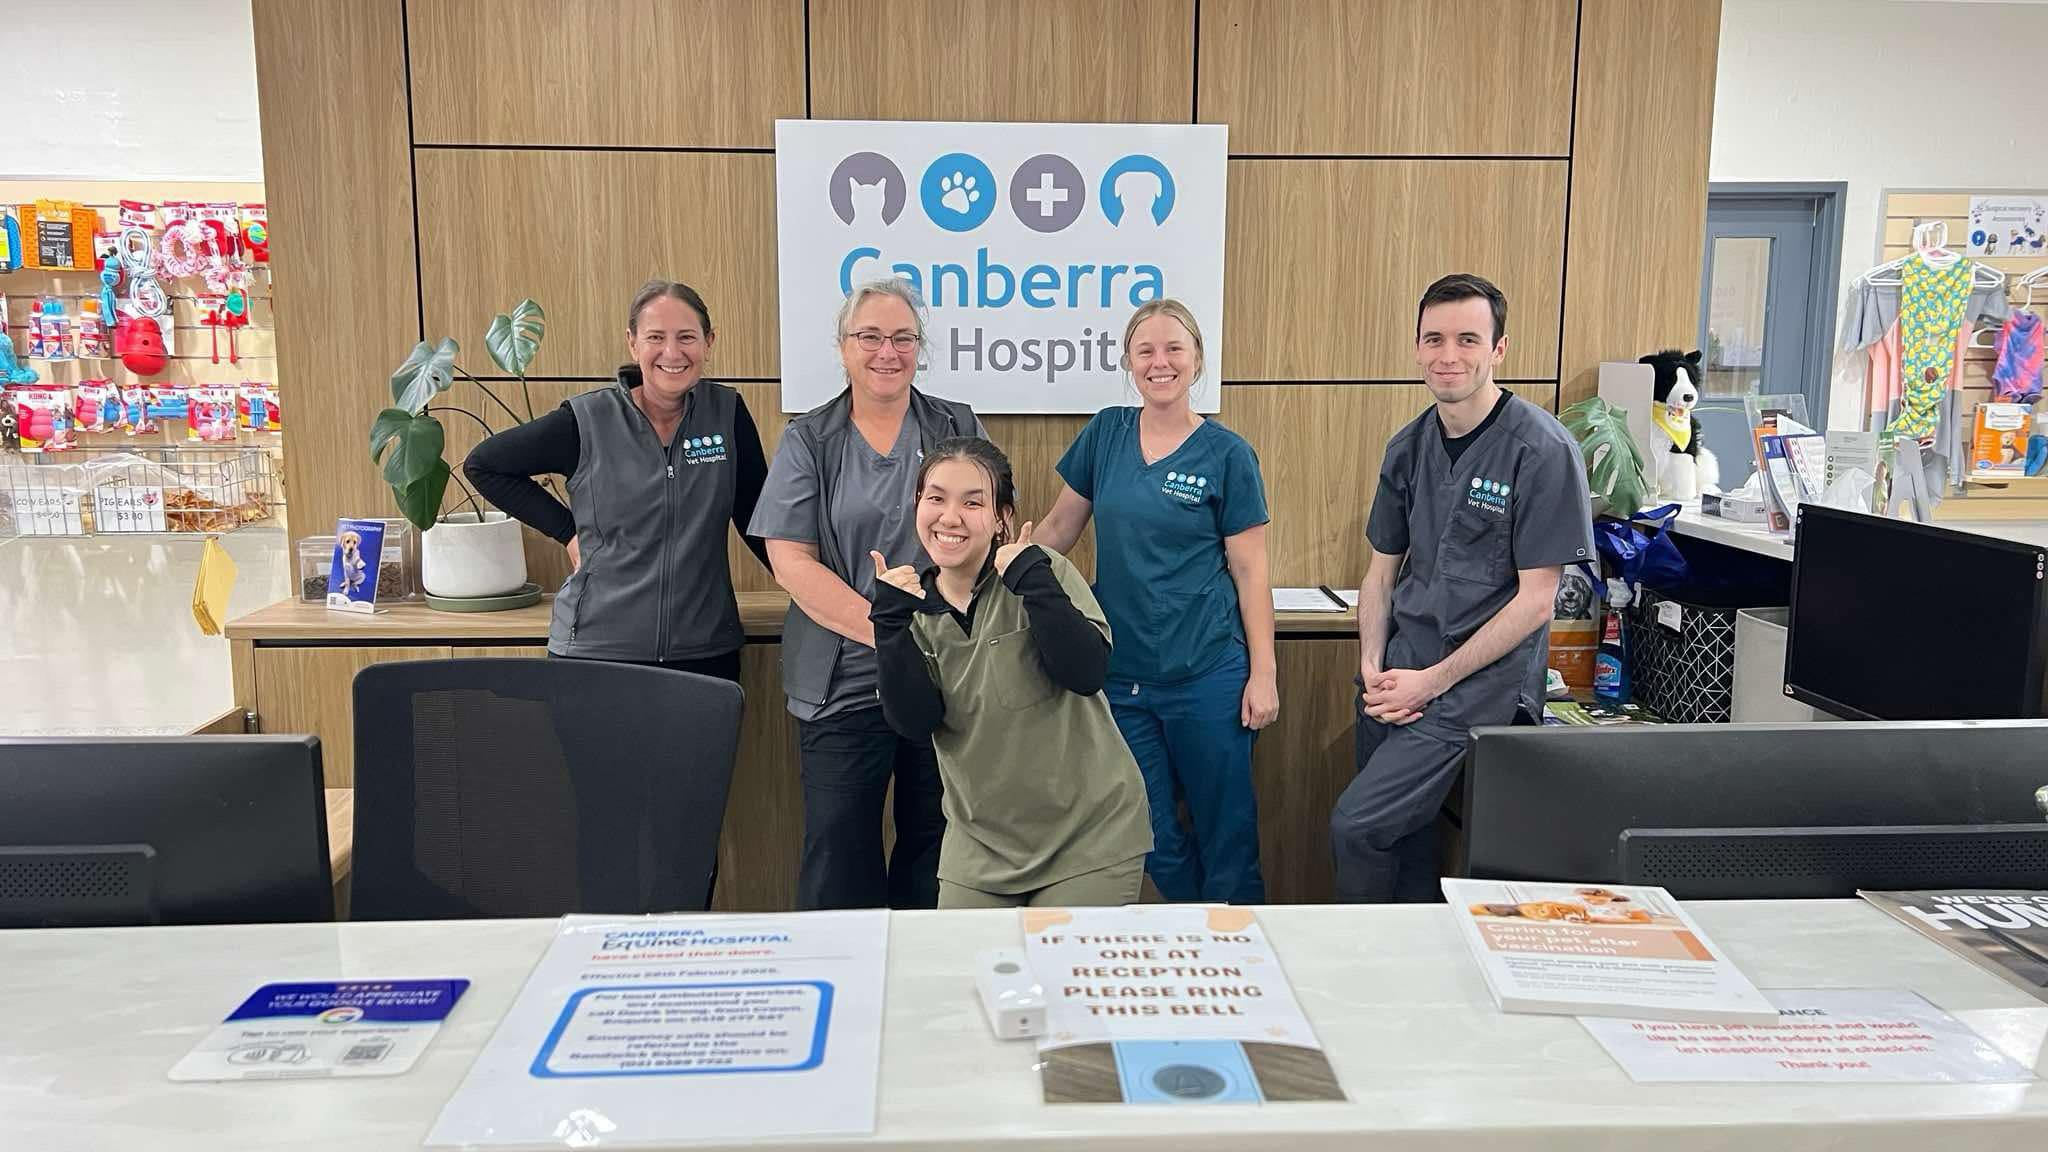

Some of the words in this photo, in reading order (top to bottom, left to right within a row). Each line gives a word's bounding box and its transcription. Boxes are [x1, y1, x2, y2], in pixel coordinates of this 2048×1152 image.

[840, 246, 1164, 308] Canberra
[950, 327, 1132, 383] Hospit
[685, 446, 725, 457] Canberra
[700, 454, 727, 463] Hospital
[1164, 480, 1203, 496] Canberra
[1173, 490, 1201, 503] Hospital
[1469, 488, 1506, 506] Canberra
[1467, 498, 1480, 508] Vet
[1481, 502, 1505, 515] Hospital
[1931, 895, 2031, 905] WE'RE
[604, 930, 705, 939] CANBERRA
[1487, 924, 1556, 936] Caring
[1561, 926, 1591, 936] for
[601, 937, 688, 951] Equine
[690, 935, 792, 945] HOSPITAL
[1041, 935, 1065, 944] IF
[1077, 935, 1166, 944] THERE
[1176, 935, 1203, 944] IS
[1212, 935, 1251, 944] NO
[1491, 933, 1543, 943] your
[1549, 935, 1582, 945] pet
[1589, 936, 1641, 946] after
[1496, 942, 1617, 954] vaccination
[1099, 949, 1159, 961] ONE
[1167, 949, 1203, 960] AT
[1072, 966, 1242, 978] RECEPTION
[273, 993, 298, 1001] WE
[300, 992, 351, 1000] WOULD
[353, 990, 442, 999] APPRECIATE
[1063, 985, 1177, 998] PLEASE
[1188, 985, 1264, 998] RING
[268, 1000, 308, 1009] YOUR
[309, 999, 373, 1008] GOOGLE
[1087, 1004, 1161, 1017] THIS
[1171, 1004, 1244, 1017] BELL
[1702, 1046, 1783, 1055] reception
[1776, 1060, 1829, 1068] Thank
